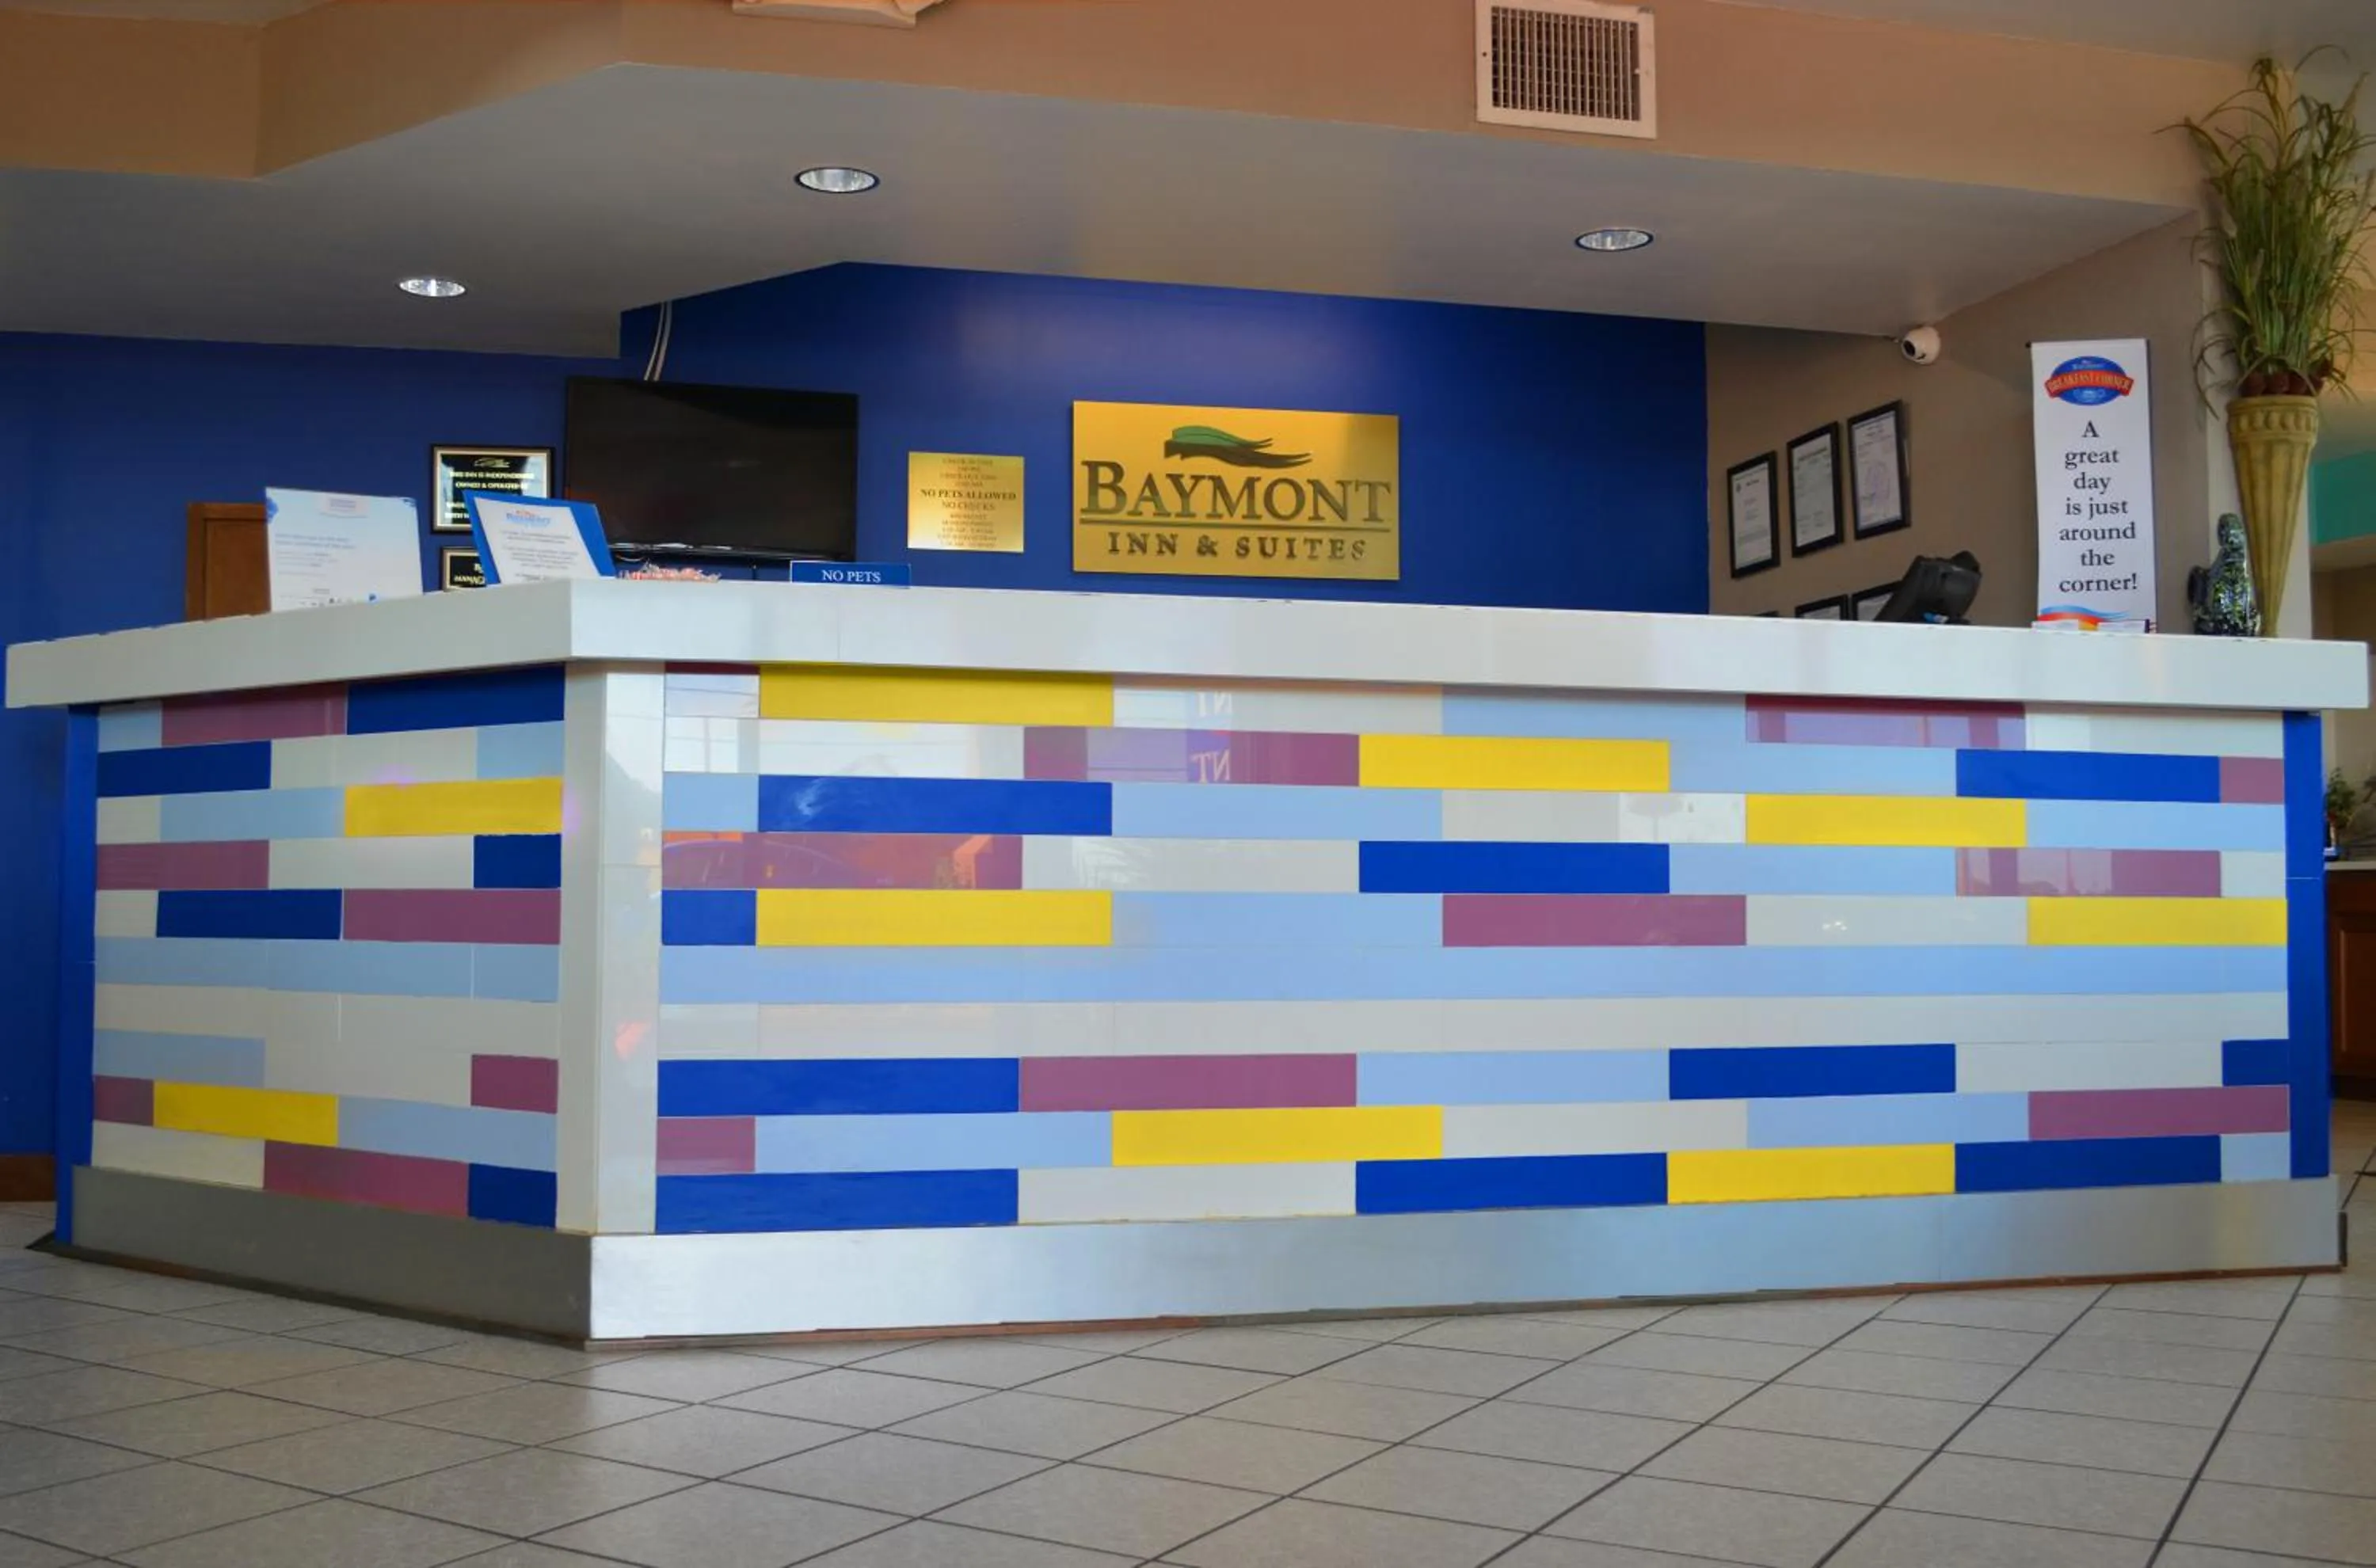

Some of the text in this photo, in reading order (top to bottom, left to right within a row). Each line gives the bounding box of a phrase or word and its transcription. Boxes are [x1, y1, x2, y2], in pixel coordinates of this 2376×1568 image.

[2082, 420, 2100, 438] A
[2065, 449, 2119, 470] great
[1079, 459, 1392, 523] BAYMONT
[2073, 472, 2111, 494] day
[920, 488, 1017, 500] NO PETS ALLOWED
[2066, 497, 2128, 520] is just
[2059, 520, 2136, 542] around
[1109, 531, 1367, 561] INN & SUITES
[2080, 549, 2115, 567] the
[822, 569, 881, 584] NO PETS
[2059, 573, 2138, 593] corner!
